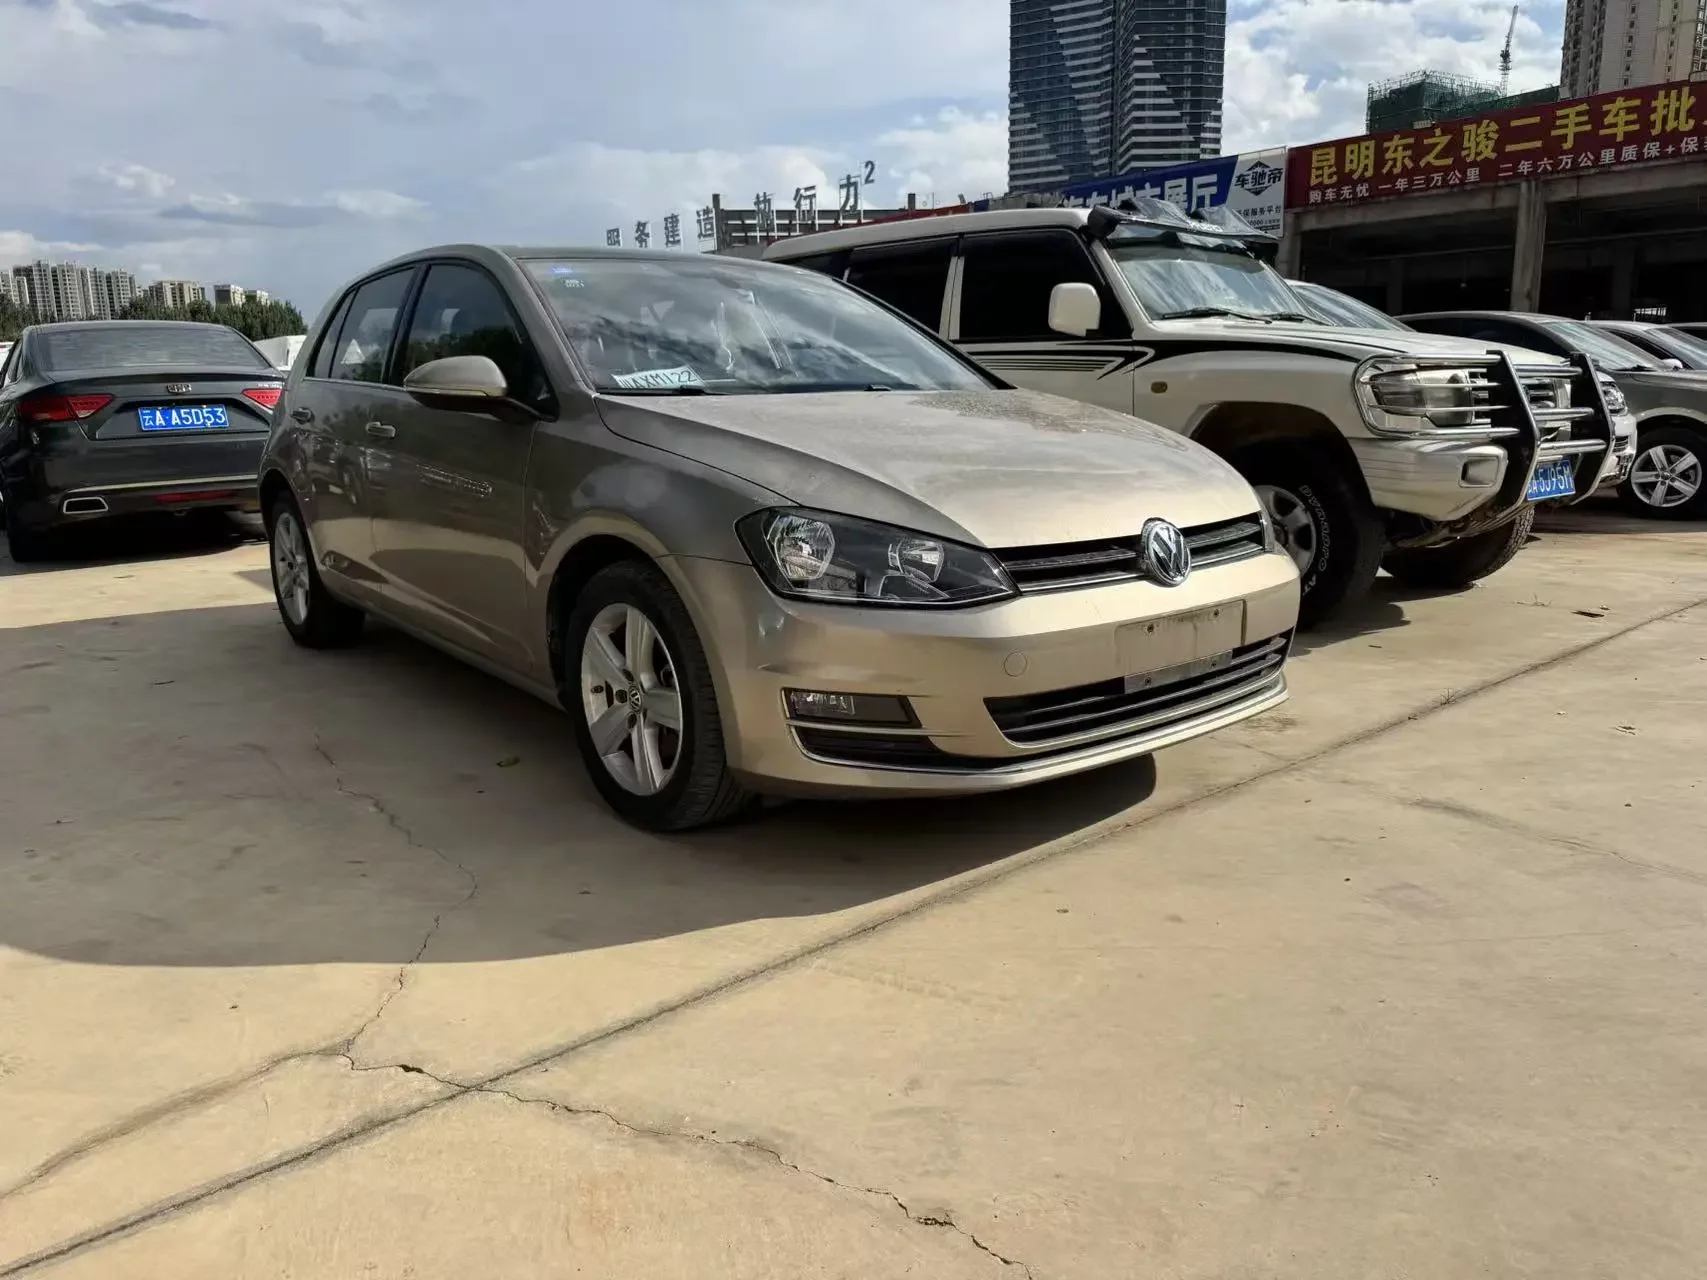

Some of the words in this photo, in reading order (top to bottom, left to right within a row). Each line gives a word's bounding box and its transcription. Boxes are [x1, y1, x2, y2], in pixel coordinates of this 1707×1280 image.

[1309, 86, 1707, 187] 昆明东之骏二手车批
[1309, 183, 1370, 204] 购车无忧
[1378, 167, 1481, 192] 一年三万公里
[1498, 136, 1707, 177] 二年六万公里质保+保
